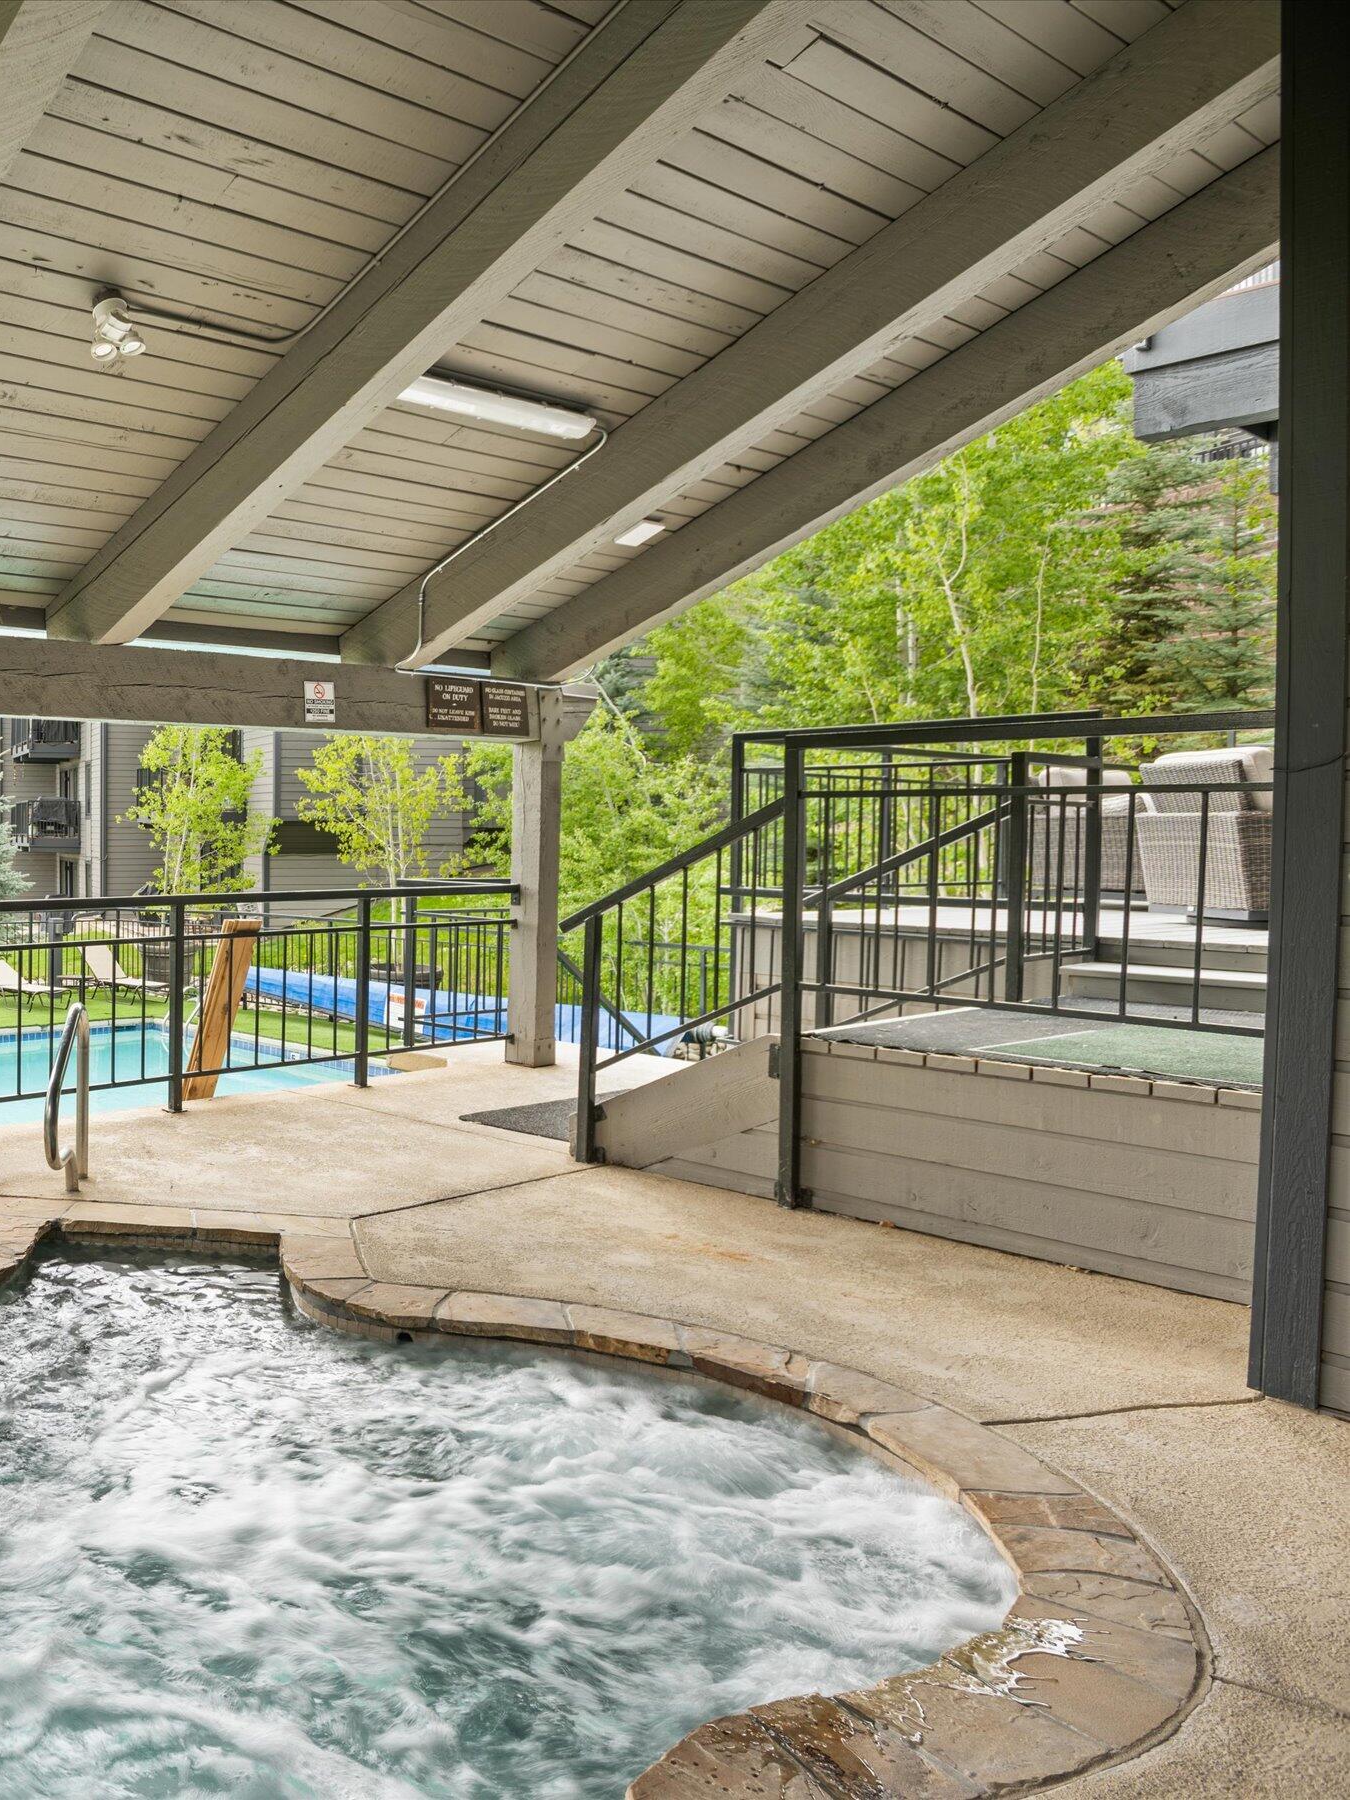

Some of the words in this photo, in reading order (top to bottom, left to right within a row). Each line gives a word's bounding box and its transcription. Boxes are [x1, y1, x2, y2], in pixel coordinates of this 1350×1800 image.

[445, 685, 474, 693] LIFEGUARD
[442, 692, 451, 700] ON
[452, 693, 468, 701] DUTY
[438, 714, 470, 722] UNATTENDED
